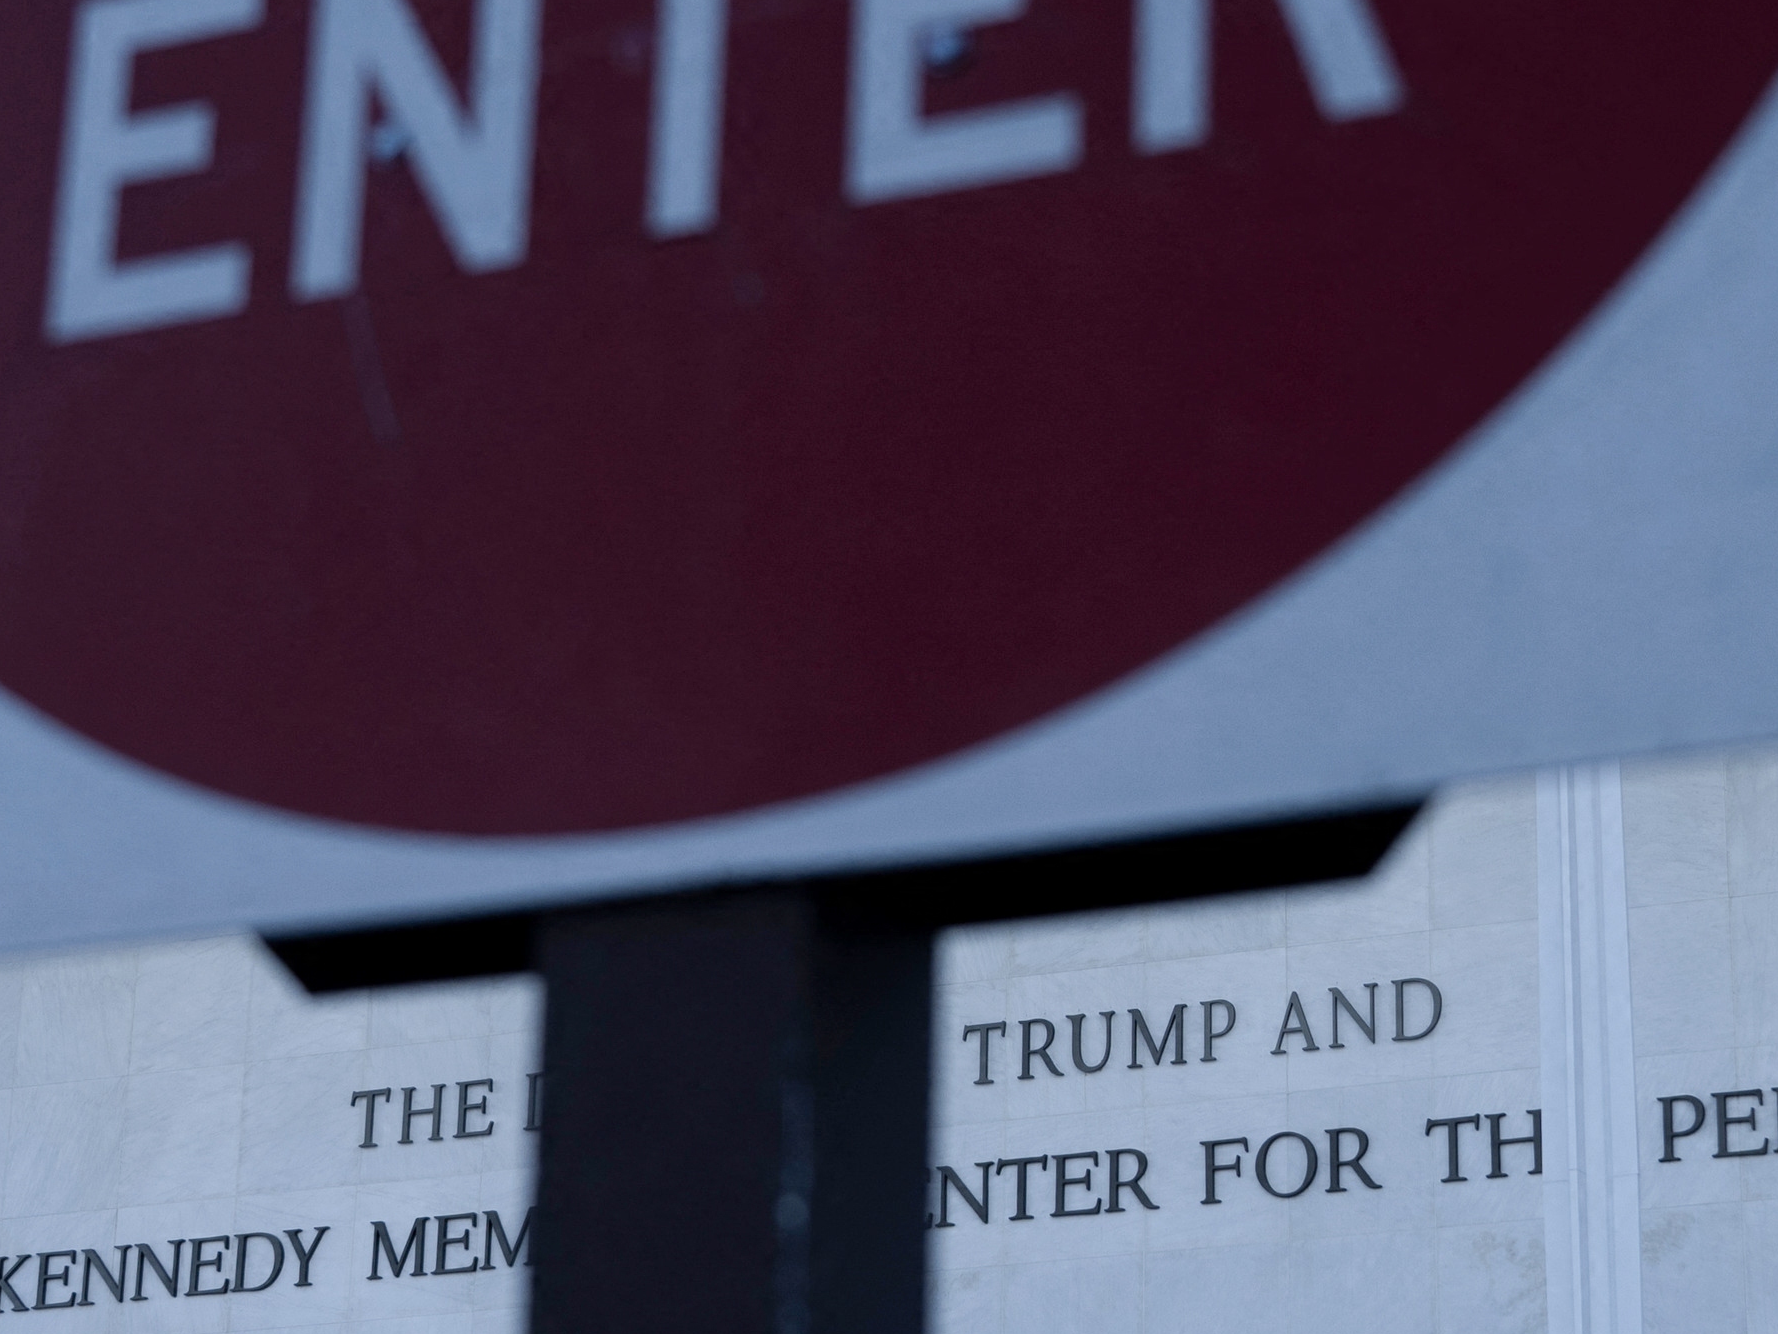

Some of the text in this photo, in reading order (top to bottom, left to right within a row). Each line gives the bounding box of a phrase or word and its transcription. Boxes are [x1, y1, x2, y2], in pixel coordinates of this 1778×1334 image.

[350, 1078, 495, 1149] THE
[962, 999, 1238, 1086] TRUMP
[1269, 977, 1444, 1056] AND
[925, 1147, 1161, 1229] NTER
[1199, 1127, 1383, 1206] FOR
[1424, 1109, 1543, 1184] TH
